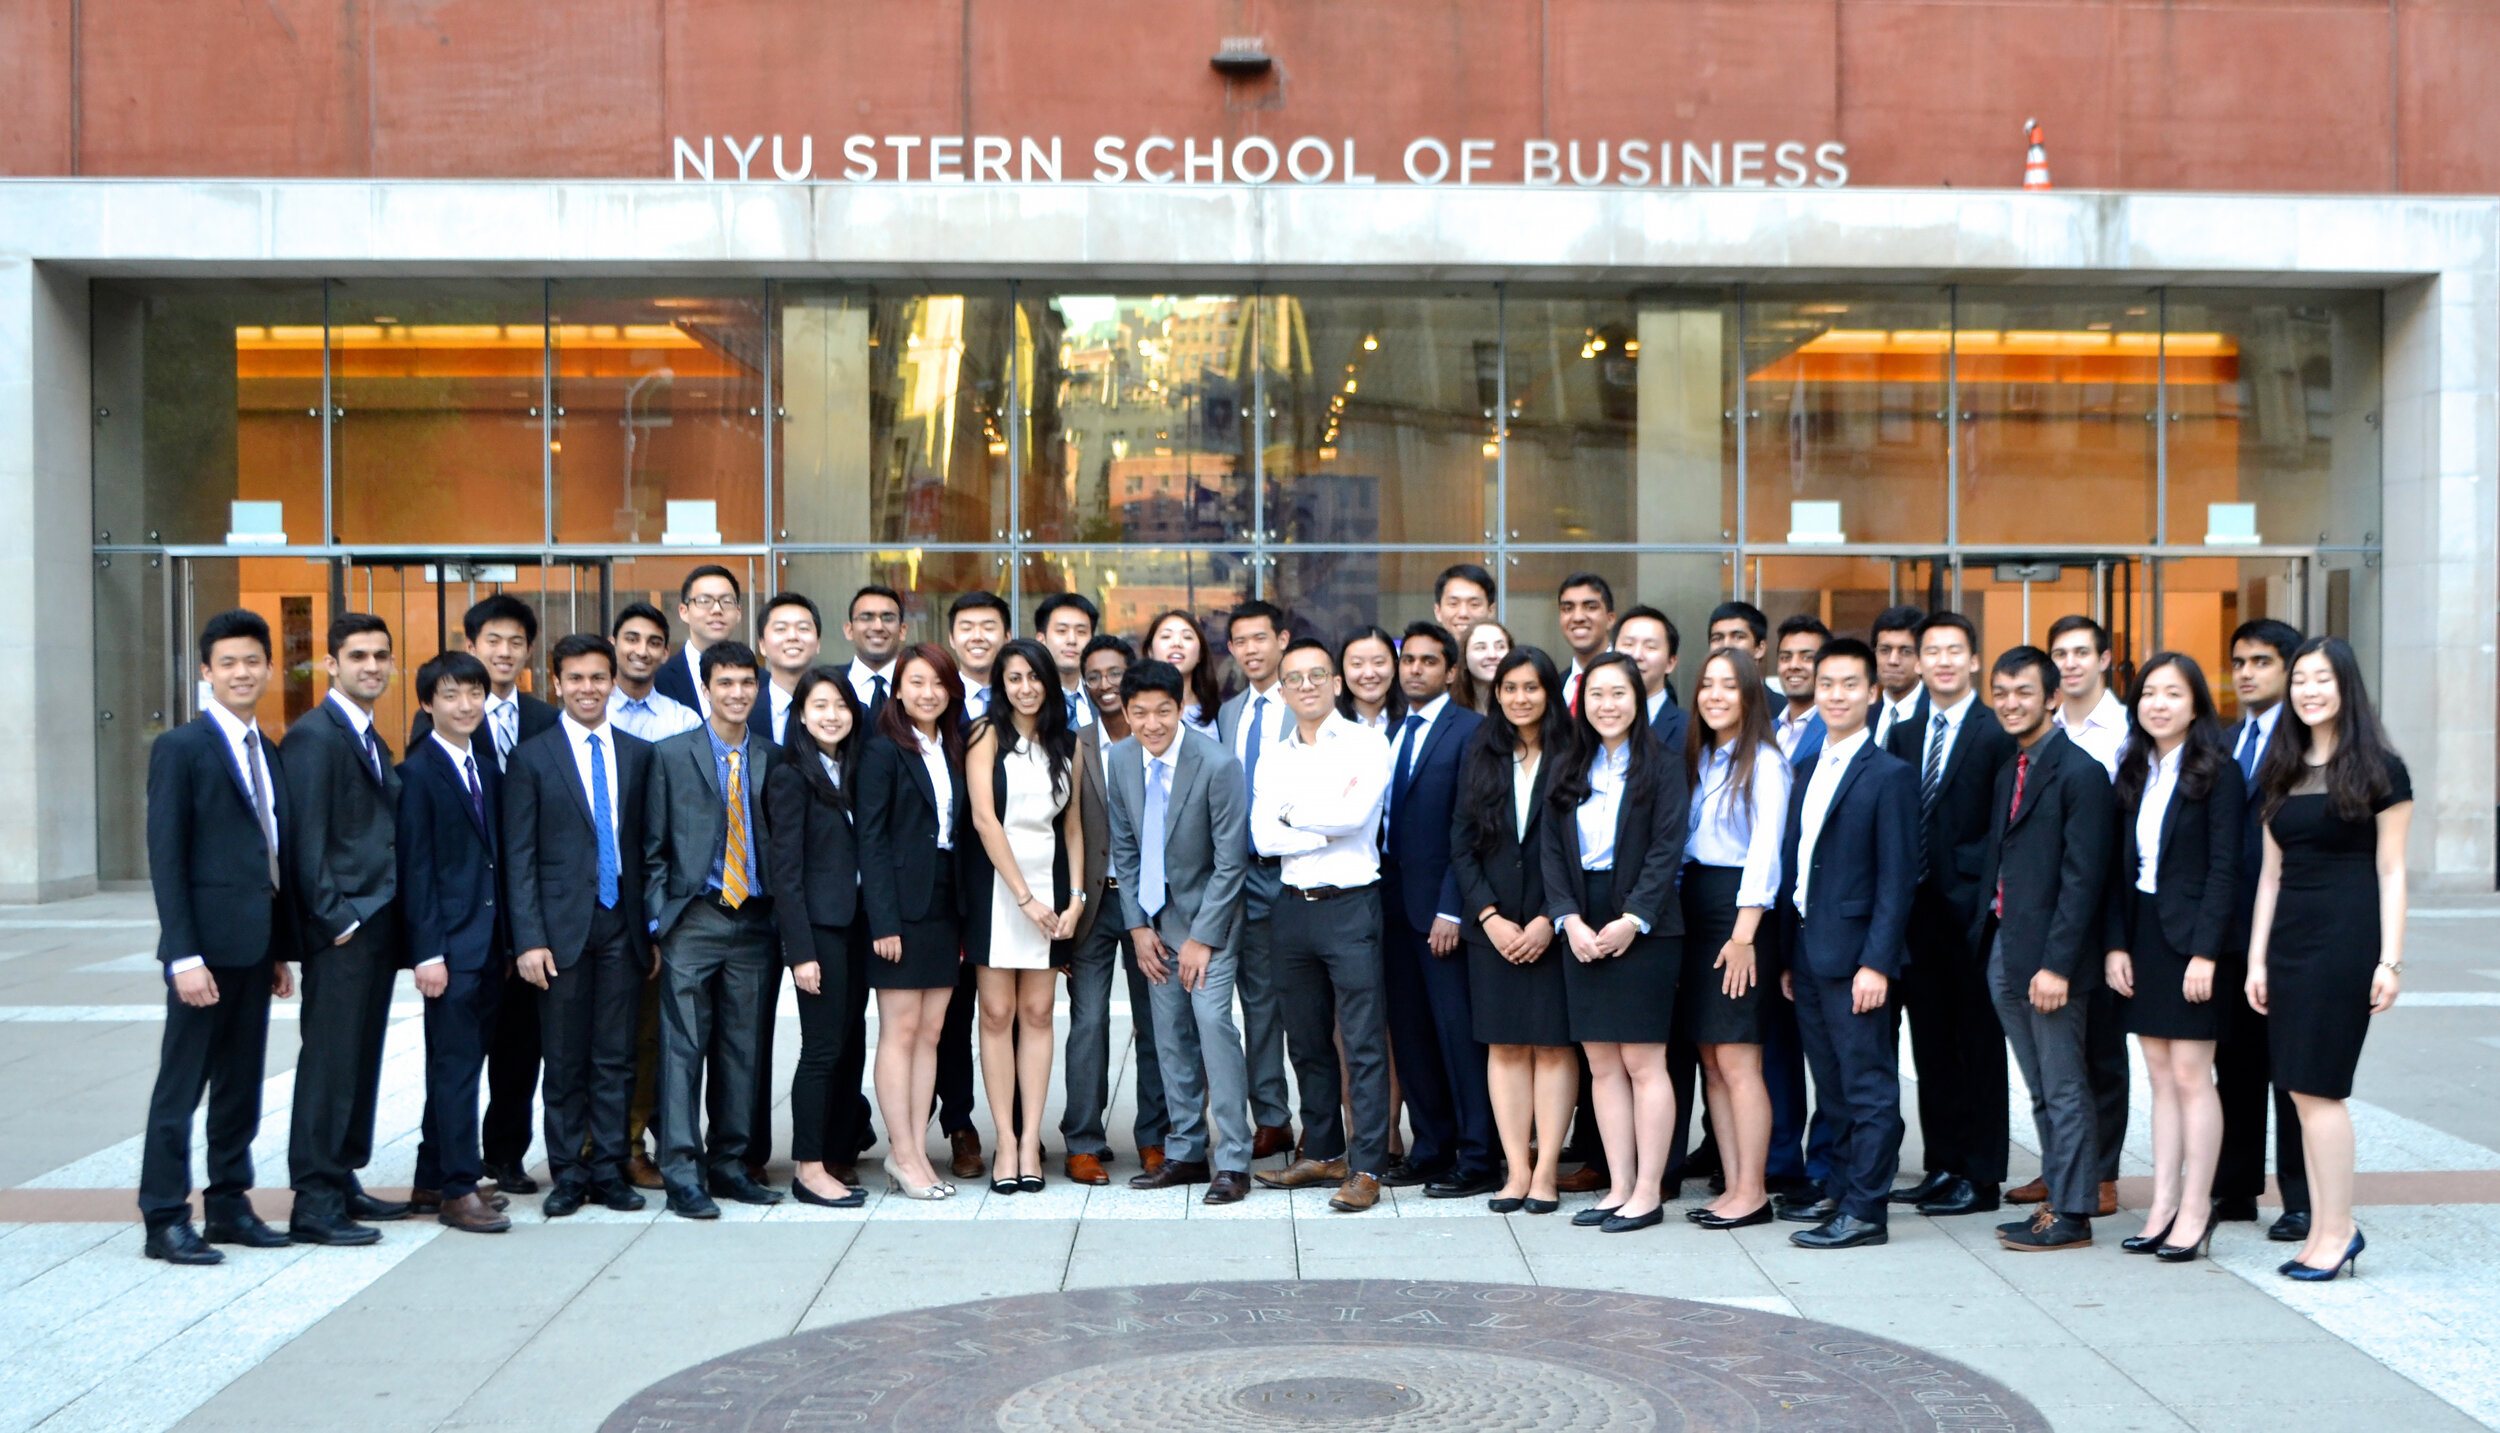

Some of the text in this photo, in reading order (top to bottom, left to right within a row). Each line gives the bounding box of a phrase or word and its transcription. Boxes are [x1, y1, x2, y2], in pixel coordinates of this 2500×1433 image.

[672, 134, 1848, 188] NYU STERN SCHOOL OF BUSINESS
[1396, 1284, 1746, 1327] GOULD
[915, 1306, 1528, 1362] MEMORIAL
[1589, 1327, 1851, 1410] PLAZA
